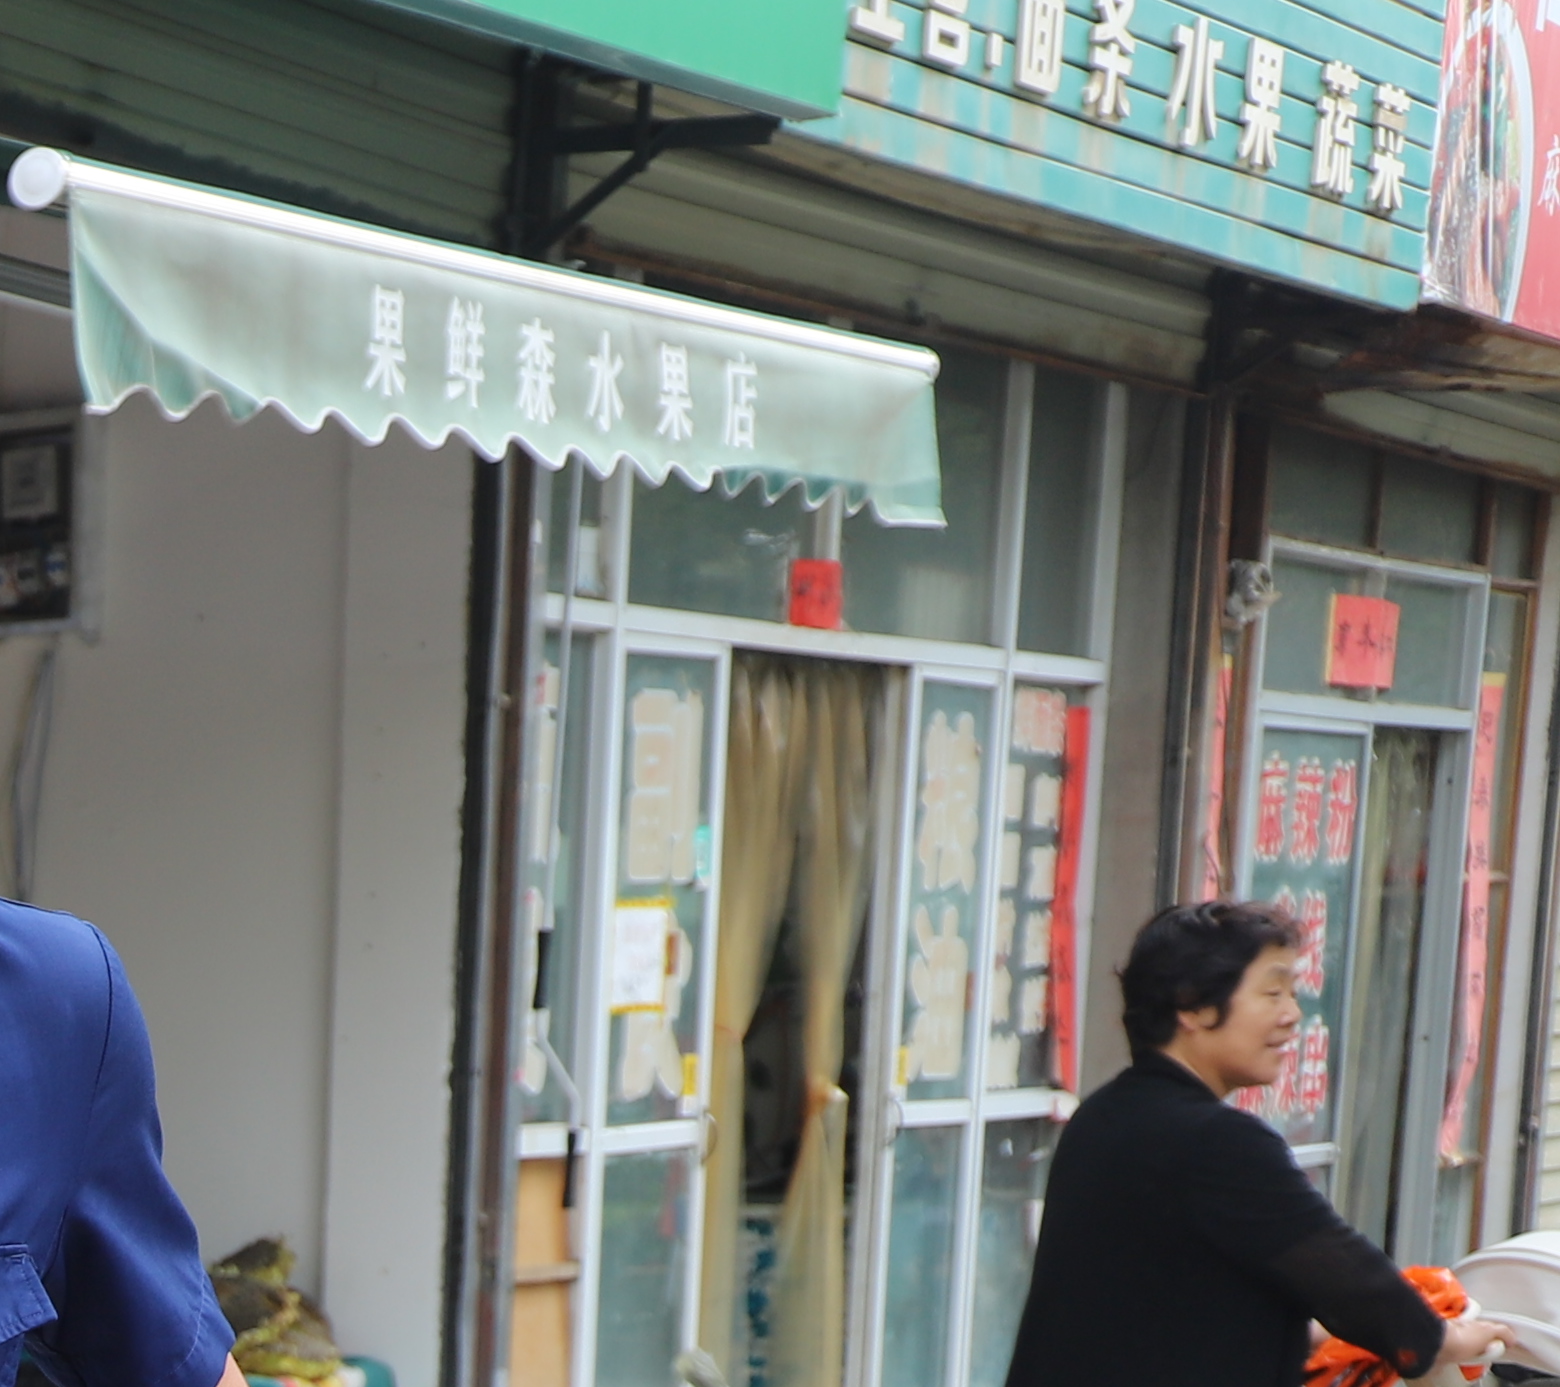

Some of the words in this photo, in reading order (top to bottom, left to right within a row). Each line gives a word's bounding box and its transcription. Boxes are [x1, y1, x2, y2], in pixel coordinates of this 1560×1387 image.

[363, 283, 758, 449] 果鲜森水果店
